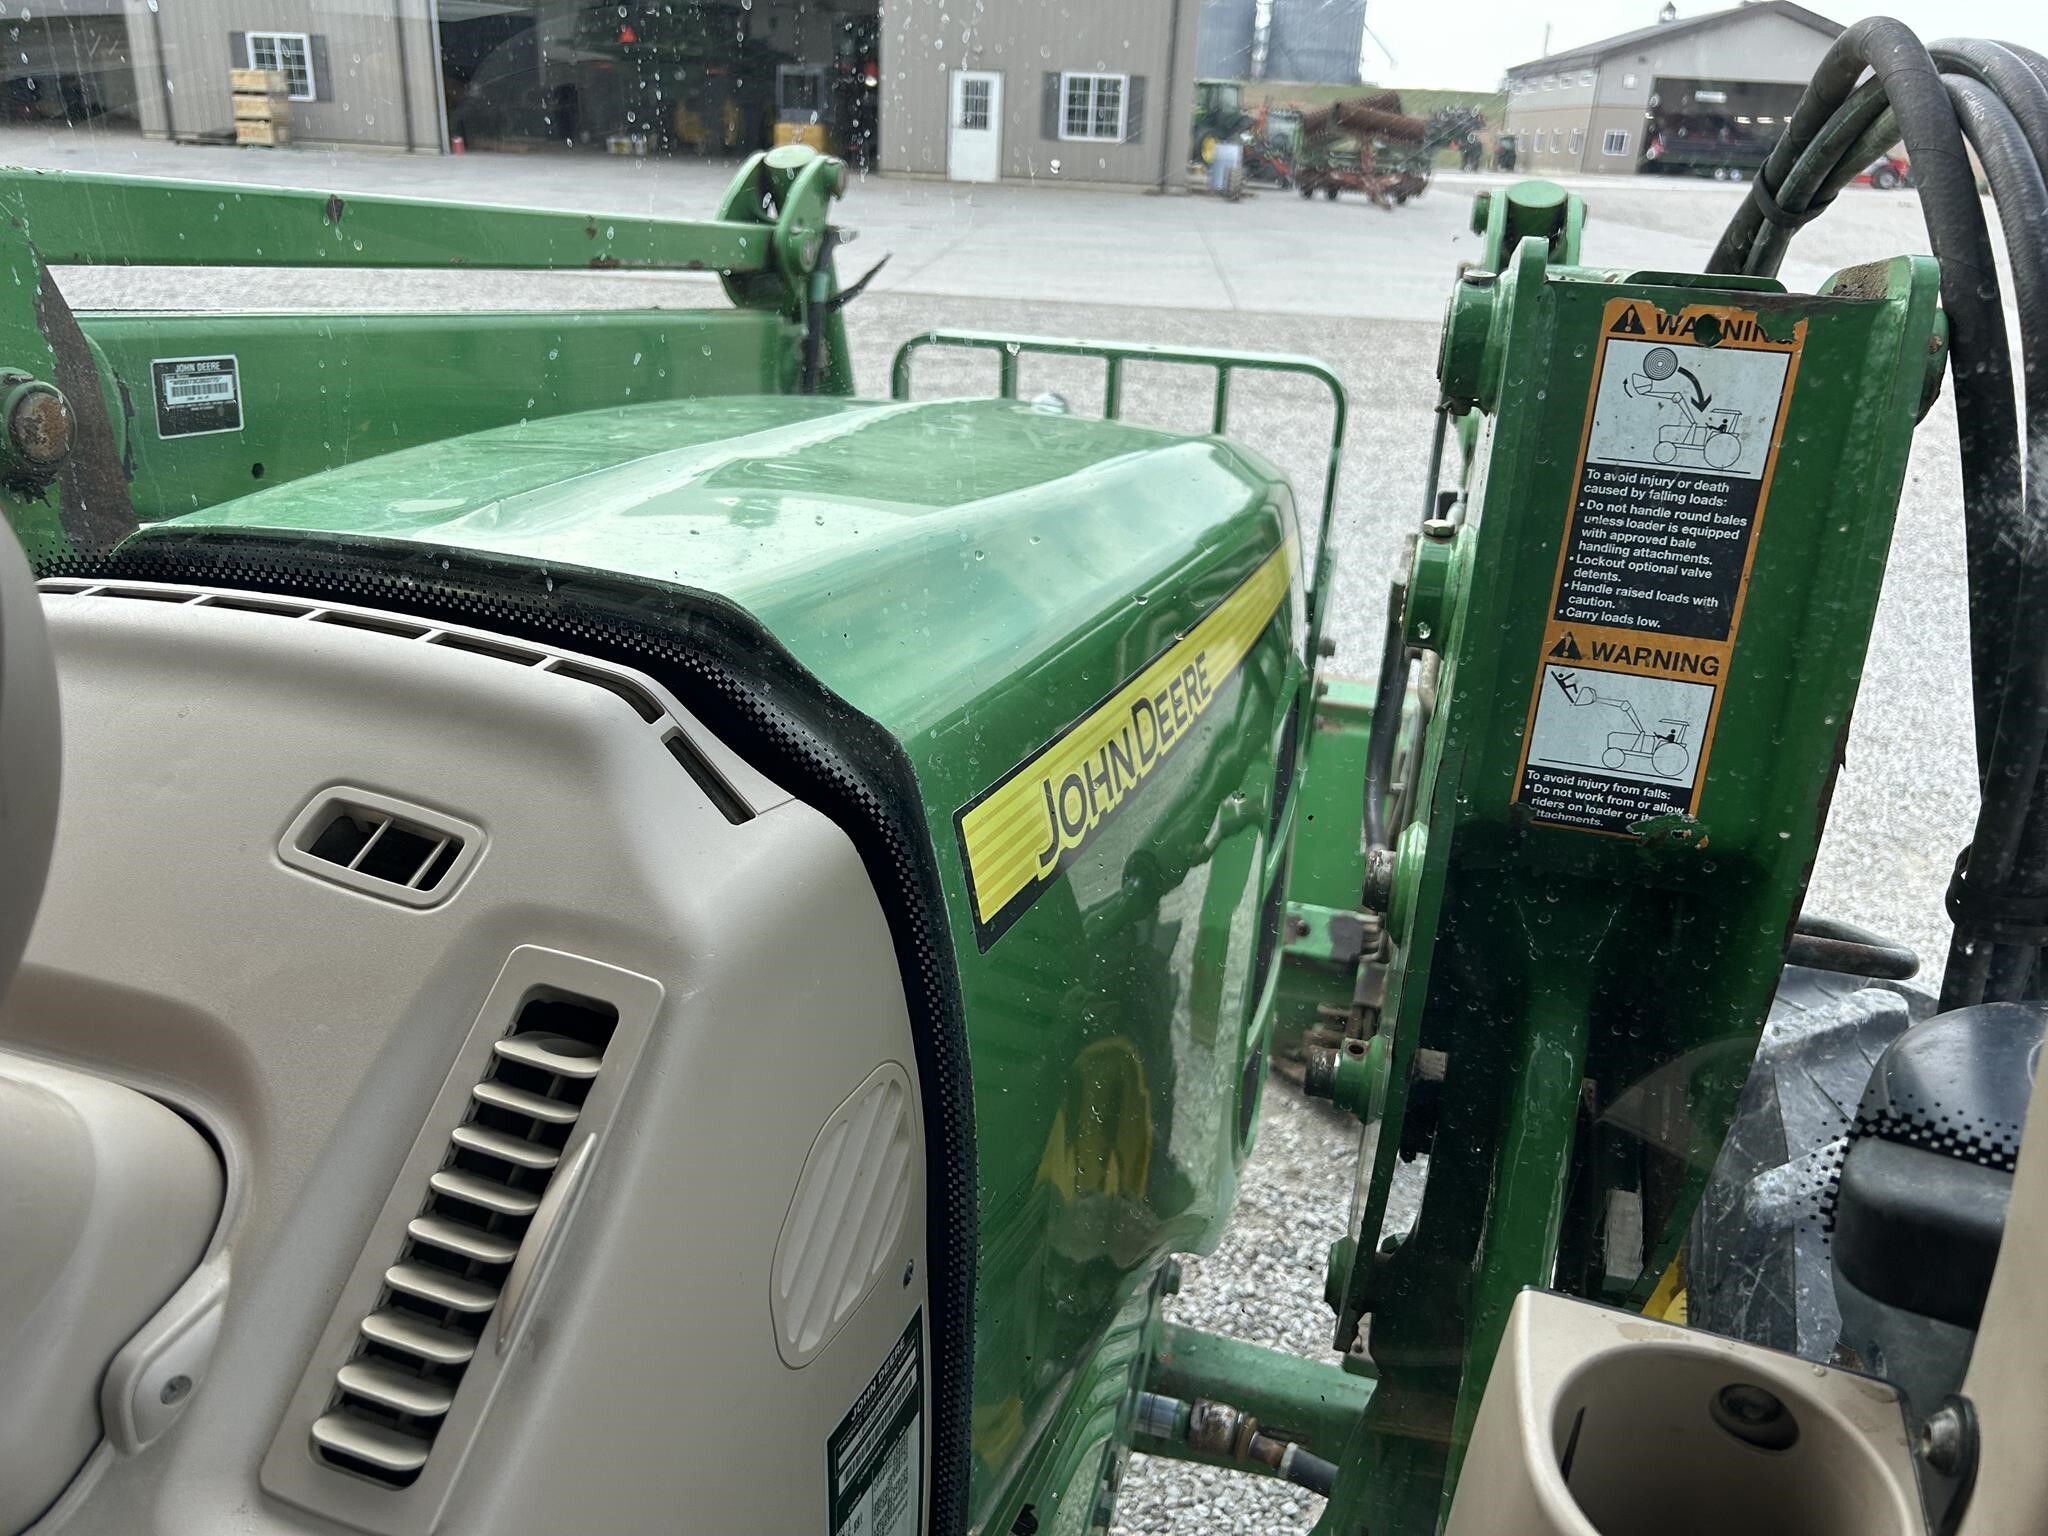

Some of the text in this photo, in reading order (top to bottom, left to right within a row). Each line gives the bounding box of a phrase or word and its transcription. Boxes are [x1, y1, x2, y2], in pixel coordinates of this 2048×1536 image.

[1587, 469, 1730, 493] To avoid injury or death
[1584, 484, 1727, 507] caused by falling loads:
[1587, 500, 1748, 527] Do not handle round bales
[1581, 528, 1697, 550] with approved bale
[1584, 514, 1740, 541] unless loader is equipped
[1578, 541, 1713, 566] handling attachments.
[1573, 567, 1622, 582] detents.
[1576, 554, 1713, 579] Lockout optional valve
[1568, 595, 1616, 609] caution.
[1570, 581, 1719, 608] Handle raised loads with
[1566, 607, 1661, 628] Carry loads low.
[1591, 641, 1720, 677] WARNING
[1039, 651, 1212, 868] JOHN DEERE
[1527, 769, 1671, 800] To avoid injury from falls:
[1531, 797, 1565, 810] riders
[1567, 803, 1583, 812] on
[1585, 804, 1623, 819] loader
[1625, 811, 1639, 821] or
[1533, 783, 1685, 815] Do not work from or allow
[1535, 809, 1604, 827] ttachments.
[851, 1381, 876, 1421] JOHN
[879, 1337, 905, 1383] DEERE
